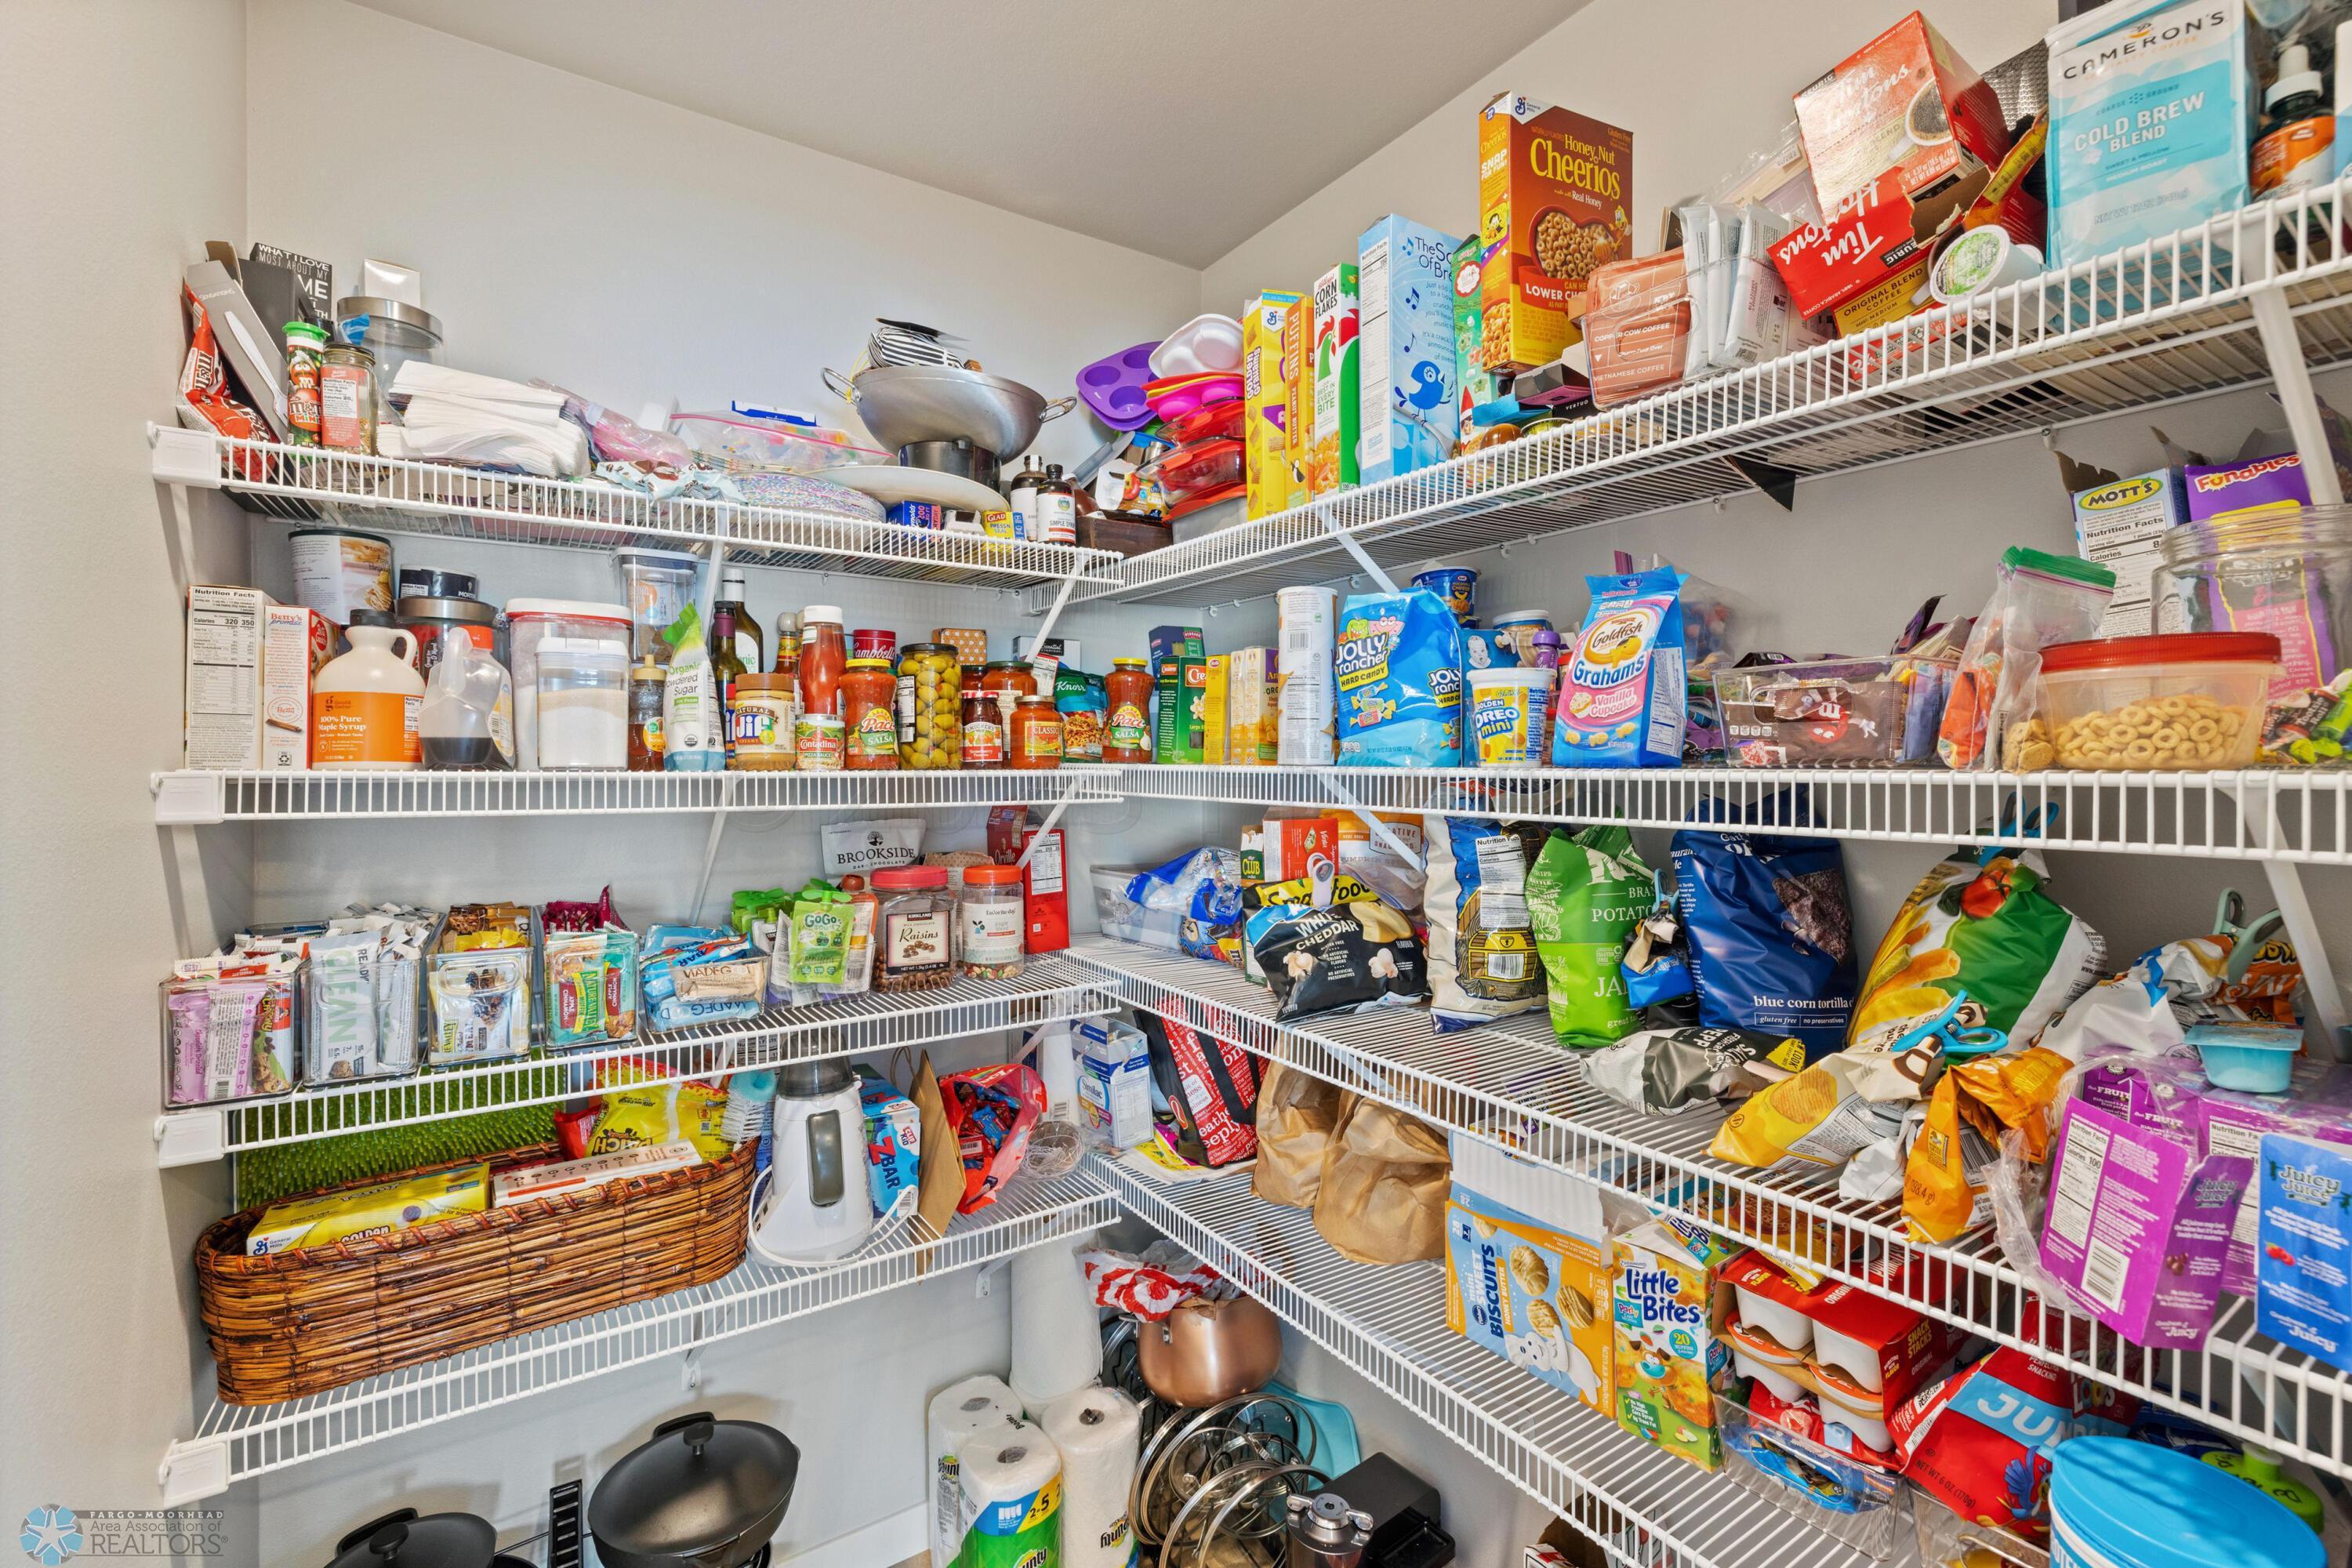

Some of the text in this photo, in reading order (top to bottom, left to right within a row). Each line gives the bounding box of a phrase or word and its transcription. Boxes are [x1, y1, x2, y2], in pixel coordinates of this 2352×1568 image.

[2074, 91, 2205, 152] COLD BREW
[1564, 133, 1615, 166] Honey Nut
[2109, 125, 2166, 153] BLEND
[1482, 149, 1507, 174] SNAP
[1530, 138, 1621, 201] Cheerios
[1415, 236, 1436, 254] The
[259, 244, 329, 271] WHAT LOVE
[259, 252, 283, 267] MOST
[1315, 279, 1337, 306] CORN
[1526, 284, 1563, 301] LOWER
[1844, 268, 1923, 316] ORIGINAL BLEND
[1867, 289, 1901, 310] COFFEE
[1315, 294, 1338, 319] FLAKES
[1642, 322, 1670, 335] COFFEE
[1289, 313, 1299, 381] PUFFINS
[1593, 364, 1664, 383] VIETNAMESE COFFEE
[1317, 397, 1335, 415] BITE
[2089, 482, 2152, 506] MOTT'S
[986, 513, 1006, 522] GLAD
[2087, 517, 2164, 539] Nutrition Facts
[2090, 551, 2122, 561] Calories
[1592, 620, 1643, 648] Goldfish
[1337, 633, 1386, 664] JOLLY
[1338, 650, 1388, 676] rancher
[1573, 654, 1645, 686] Grahams
[1055, 681, 1087, 691] Knorr
[1341, 675, 1359, 688] HARD
[1590, 697, 1637, 719] Cupcake
[1595, 688, 1635, 706] Vanilla
[339, 723, 366, 731] Syrup
[868, 735, 893, 745] SALSA
[1477, 837, 1504, 846] Nutrition
[1242, 860, 1260, 874] CLUB
[899, 927, 938, 942] Raisins
[1296, 920, 1359, 950] CHEDDAR
[1754, 996, 1849, 1009] blue corn tortilla
[1759, 1015, 1781, 1025] gluten
[1782, 1015, 1797, 1025] free
[1812, 1016, 1844, 1025] preservatives
[2089, 1156, 2102, 1169] 100
[1472, 1250, 1486, 1305] SWEET
[1626, 1268, 1679, 1300] Little
[1481, 1243, 1504, 1339] BISCUITS
[1643, 1296, 1700, 1324] Bites
[1674, 1332, 1690, 1346] 20
[1907, 1319, 1930, 1344] SNACK
[1907, 1332, 1933, 1359] STACKS
[1916, 1460, 1926, 1472] NET
[1927, 1468, 1939, 1479] WT
[1945, 1481, 1955, 1492] OZ
